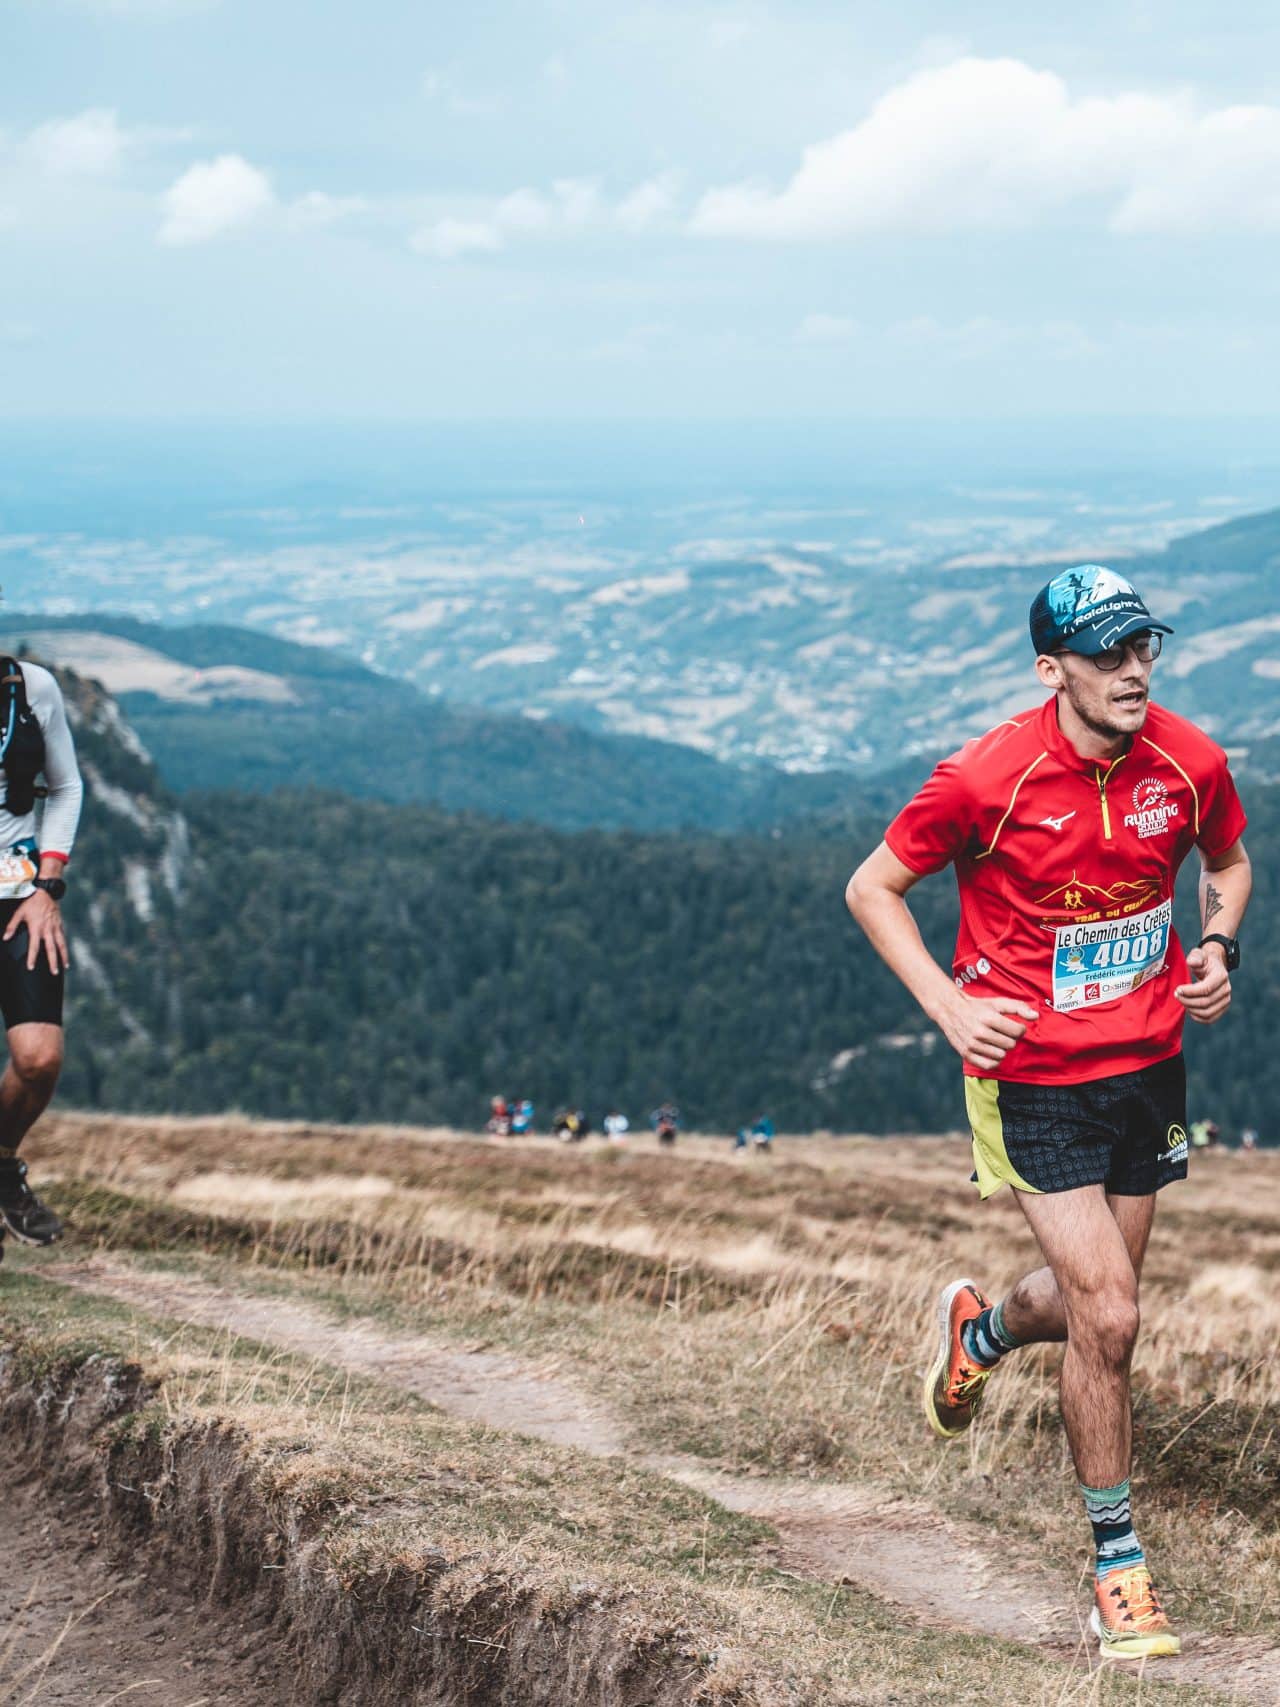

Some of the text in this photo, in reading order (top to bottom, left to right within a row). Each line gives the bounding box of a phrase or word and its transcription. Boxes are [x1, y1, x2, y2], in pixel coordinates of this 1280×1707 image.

[1124, 803, 1179, 827] RUNNING
[1058, 908, 1170, 947] Le Chemin des Crêtes
[1093, 928, 1163, 968] 4008
[1085, 968, 1116, 982] Frédéric
